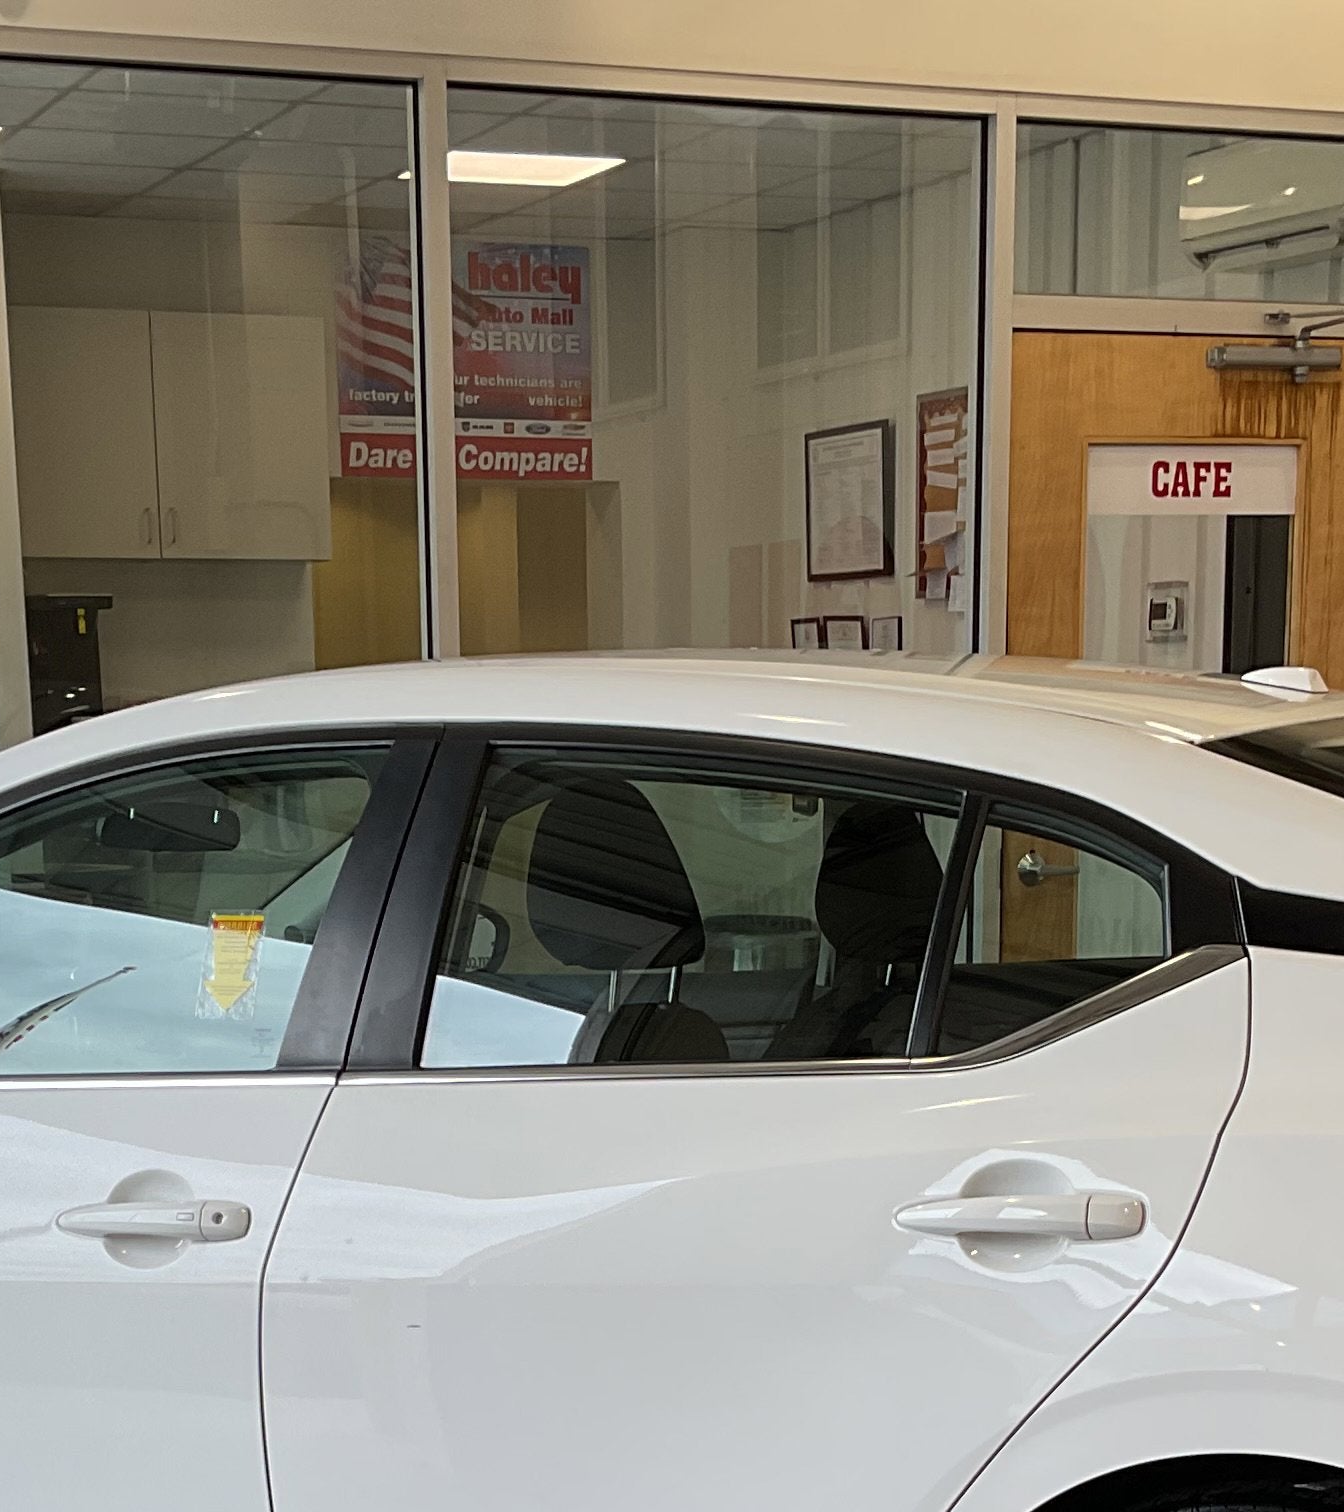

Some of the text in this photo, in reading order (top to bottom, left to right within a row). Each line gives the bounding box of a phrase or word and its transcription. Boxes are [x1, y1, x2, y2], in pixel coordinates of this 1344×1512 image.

[467, 251, 582, 304] haley
[530, 307, 574, 326] Mall
[470, 330, 582, 355] SERVICE
[454, 373, 583, 389] ur technicians are
[348, 388, 400, 405] factory
[527, 395, 583, 408] vehicle!
[348, 441, 589, 477] Dare Compare!
[1151, 460, 1233, 498] CAFE
